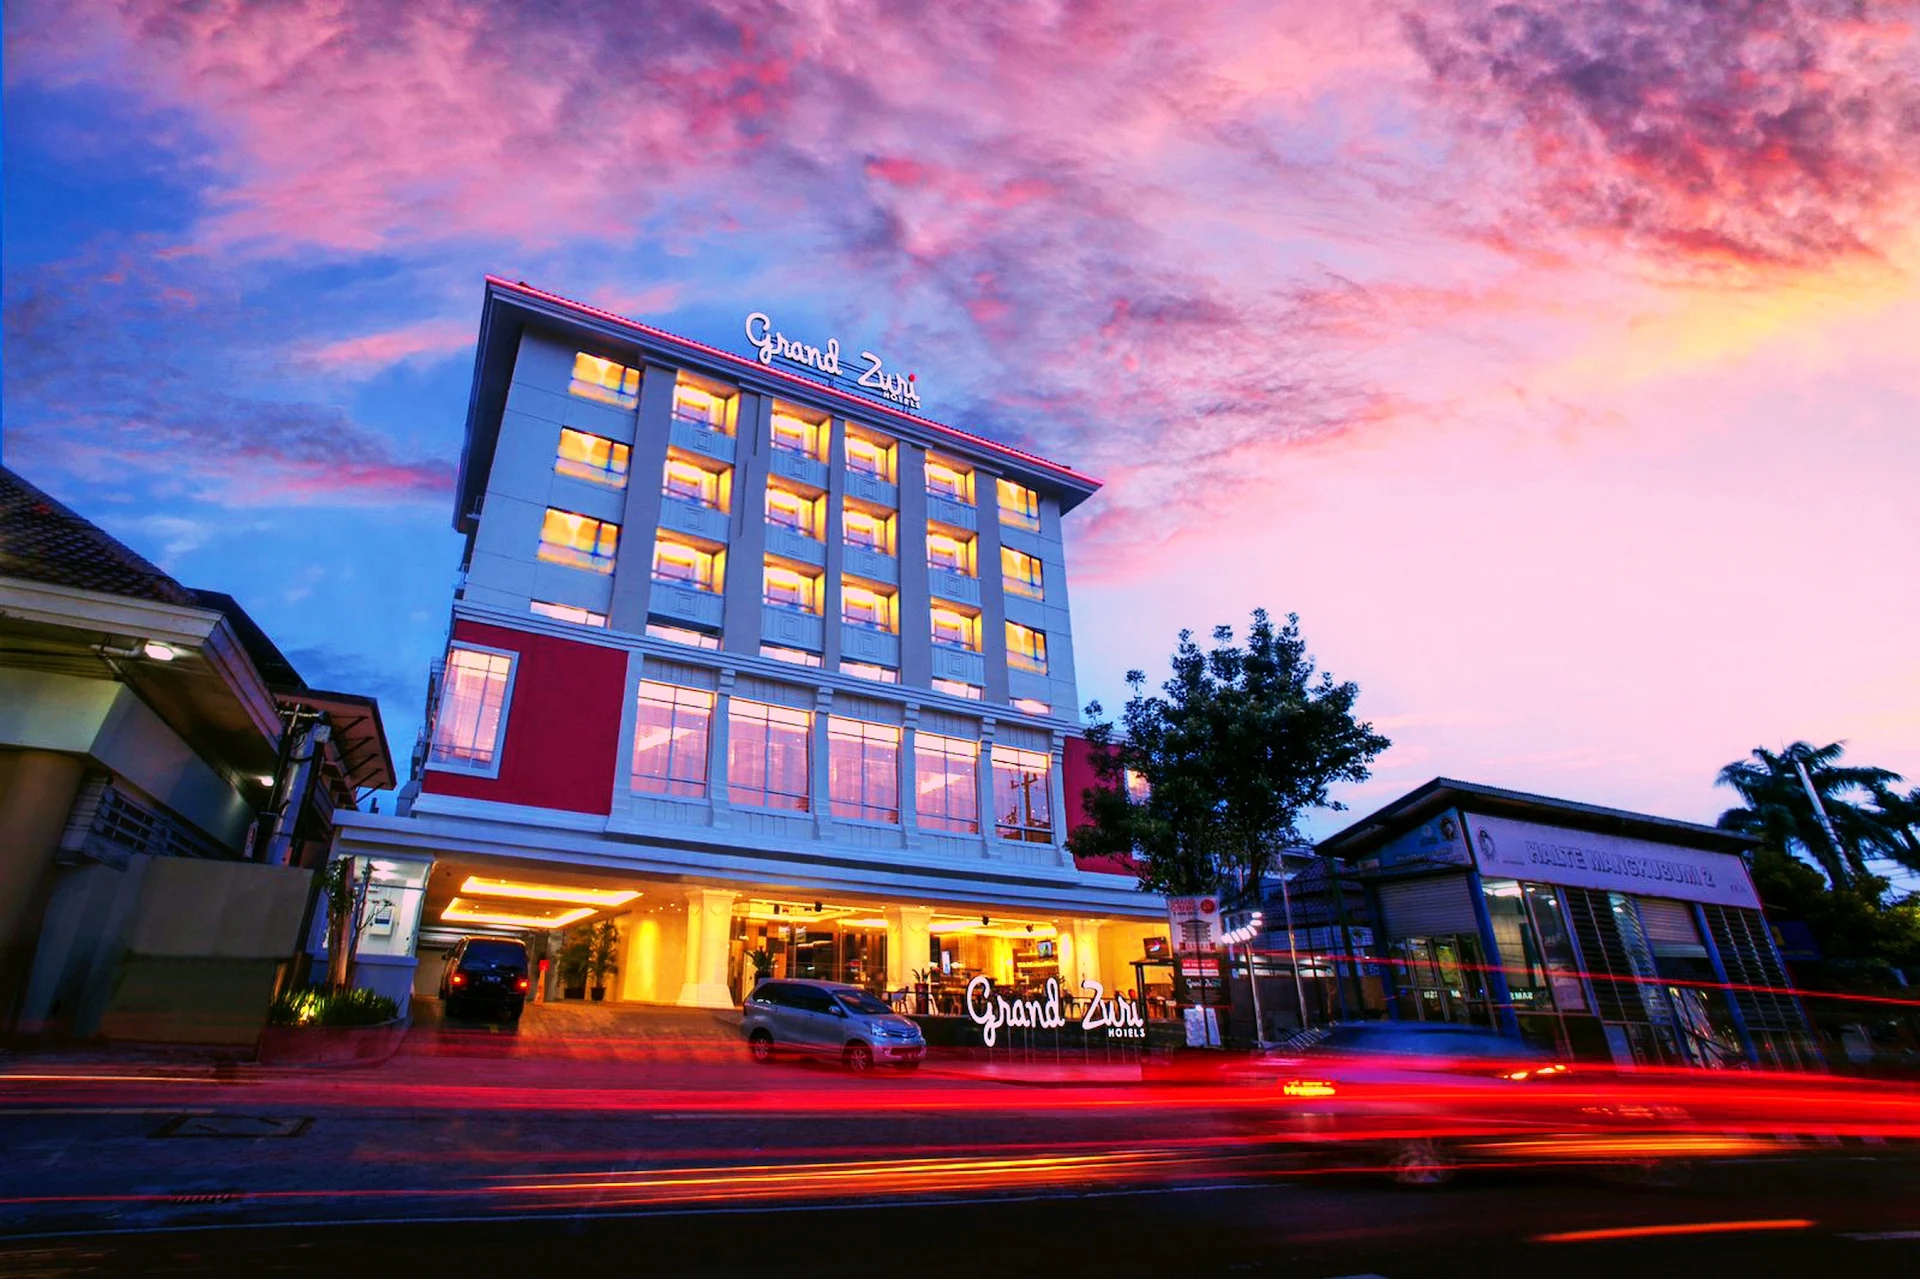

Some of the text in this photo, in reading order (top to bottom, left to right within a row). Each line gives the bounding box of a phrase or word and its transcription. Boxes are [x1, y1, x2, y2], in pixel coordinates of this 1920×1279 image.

[745, 312, 921, 401] Grand Zuri
[882, 389, 922, 409] HOTELS
[1526, 841, 1588, 869] HALTE
[967, 975, 1144, 1047] Grand Zuri
